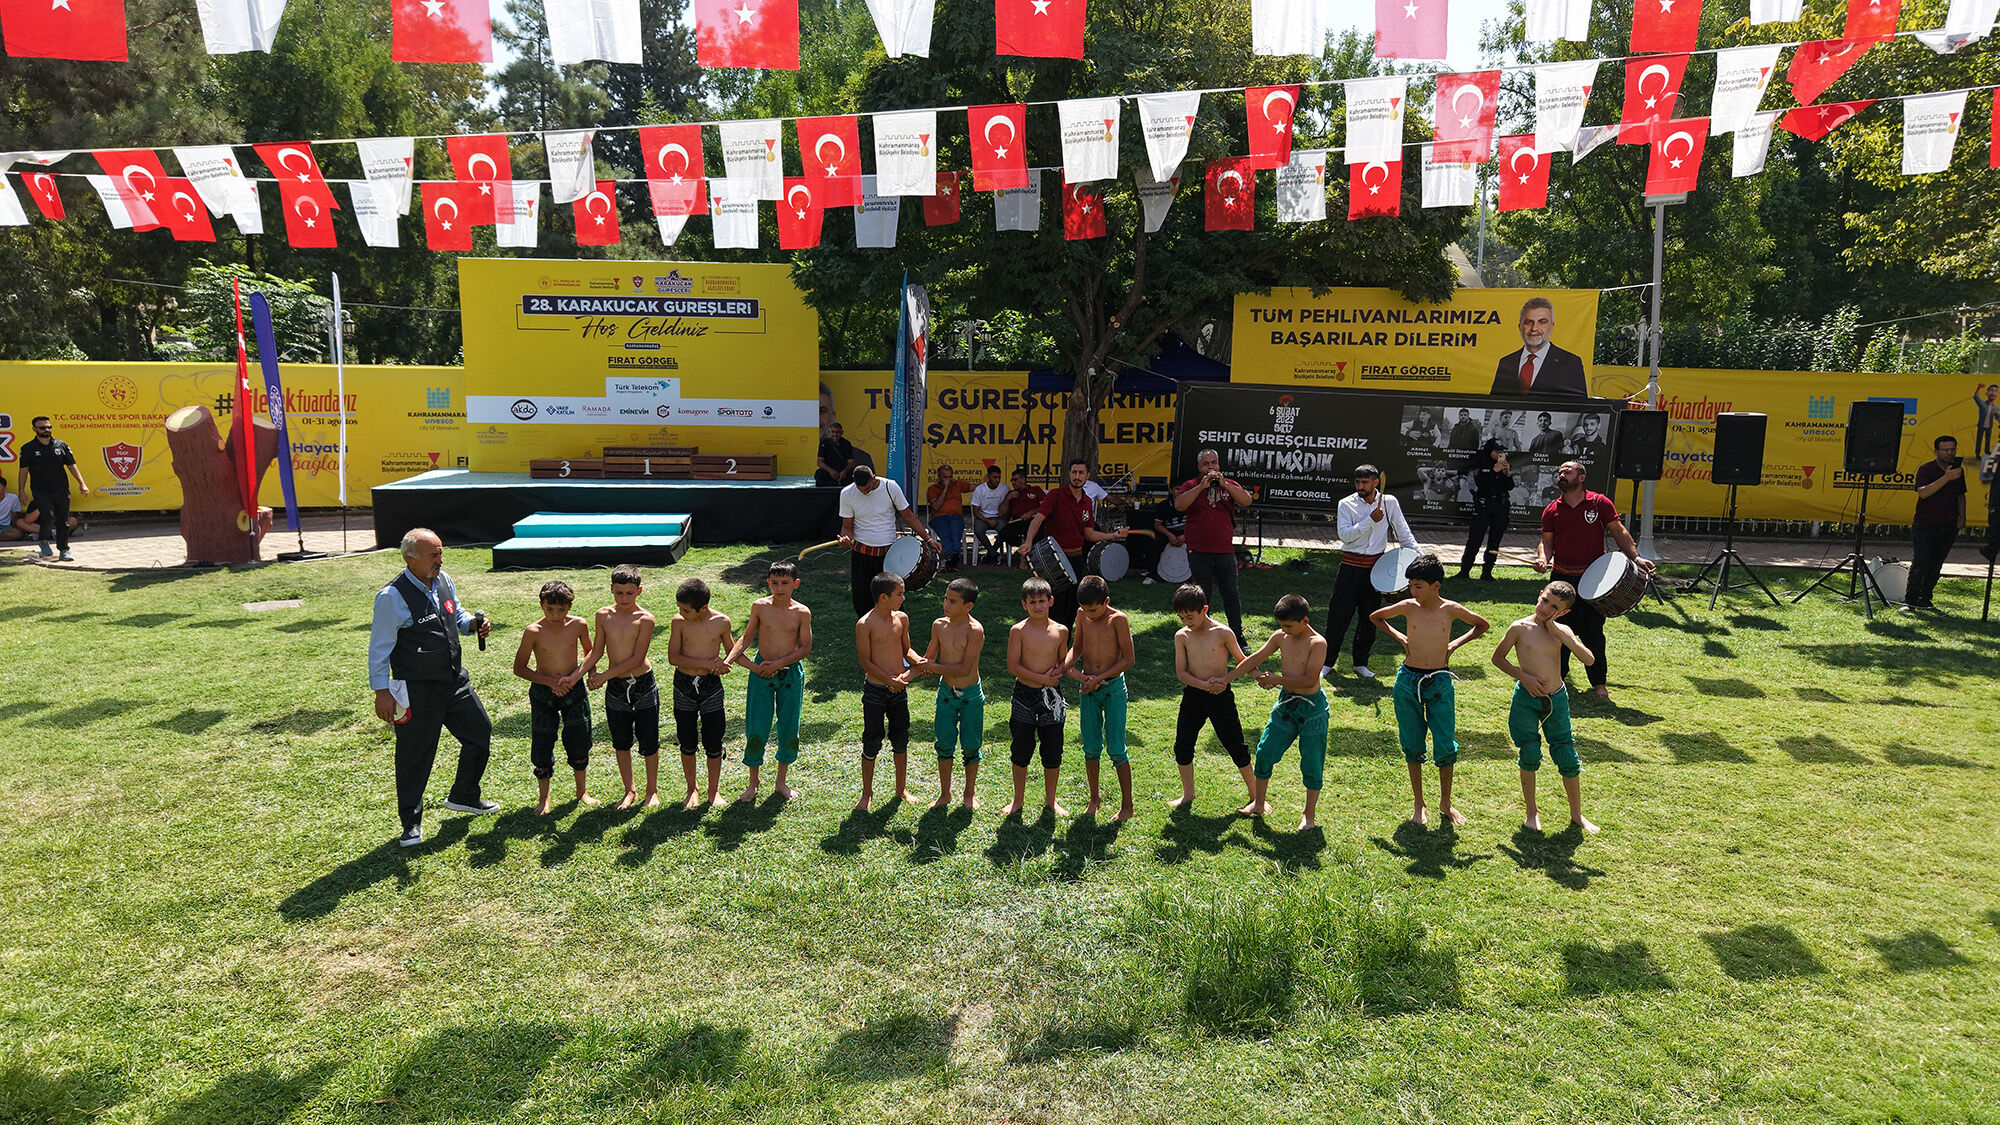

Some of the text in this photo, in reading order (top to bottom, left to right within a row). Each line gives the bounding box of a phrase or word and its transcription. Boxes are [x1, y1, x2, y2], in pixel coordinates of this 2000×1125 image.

[530, 299, 752, 316] 28. KARAKUCAK GÜREŞLERİ
[1250, 308, 1501, 325] TÜM PEHLİVANLARIMIZA
[575, 315, 709, 342] Hoş Geldiniz
[1271, 331, 1477, 348] BAŞARILAR DİLERİM
[608, 356, 679, 365] FIRAT GÖRGEL
[1361, 364, 1451, 375] FIRAT GÖRGEL
[614, 383, 660, 391] Türk Telekom
[678, 407, 710, 416] komagene
[1269, 406, 1275, 415] 6
[53, 413, 69, 421] T.C.
[69, 413, 105, 422] GENÇLİK
[106, 413, 117, 421] VE
[118, 413, 140, 421] SPOR
[1276, 415, 1294, 424] 2023
[1785, 421, 1847, 429] KAHRAMANMAR
[1198, 430, 1368, 450] ŞEHİT GÜREŞÇİLERİMİZ
[559, 460, 571, 477] 3
[643, 458, 652, 475] 1
[725, 458, 737, 475] 2
[1236, 470, 1281, 479] Şehitlerimizi
[1281, 472, 1313, 481] Rahmetle
[1270, 488, 1294, 497] FIRAT
